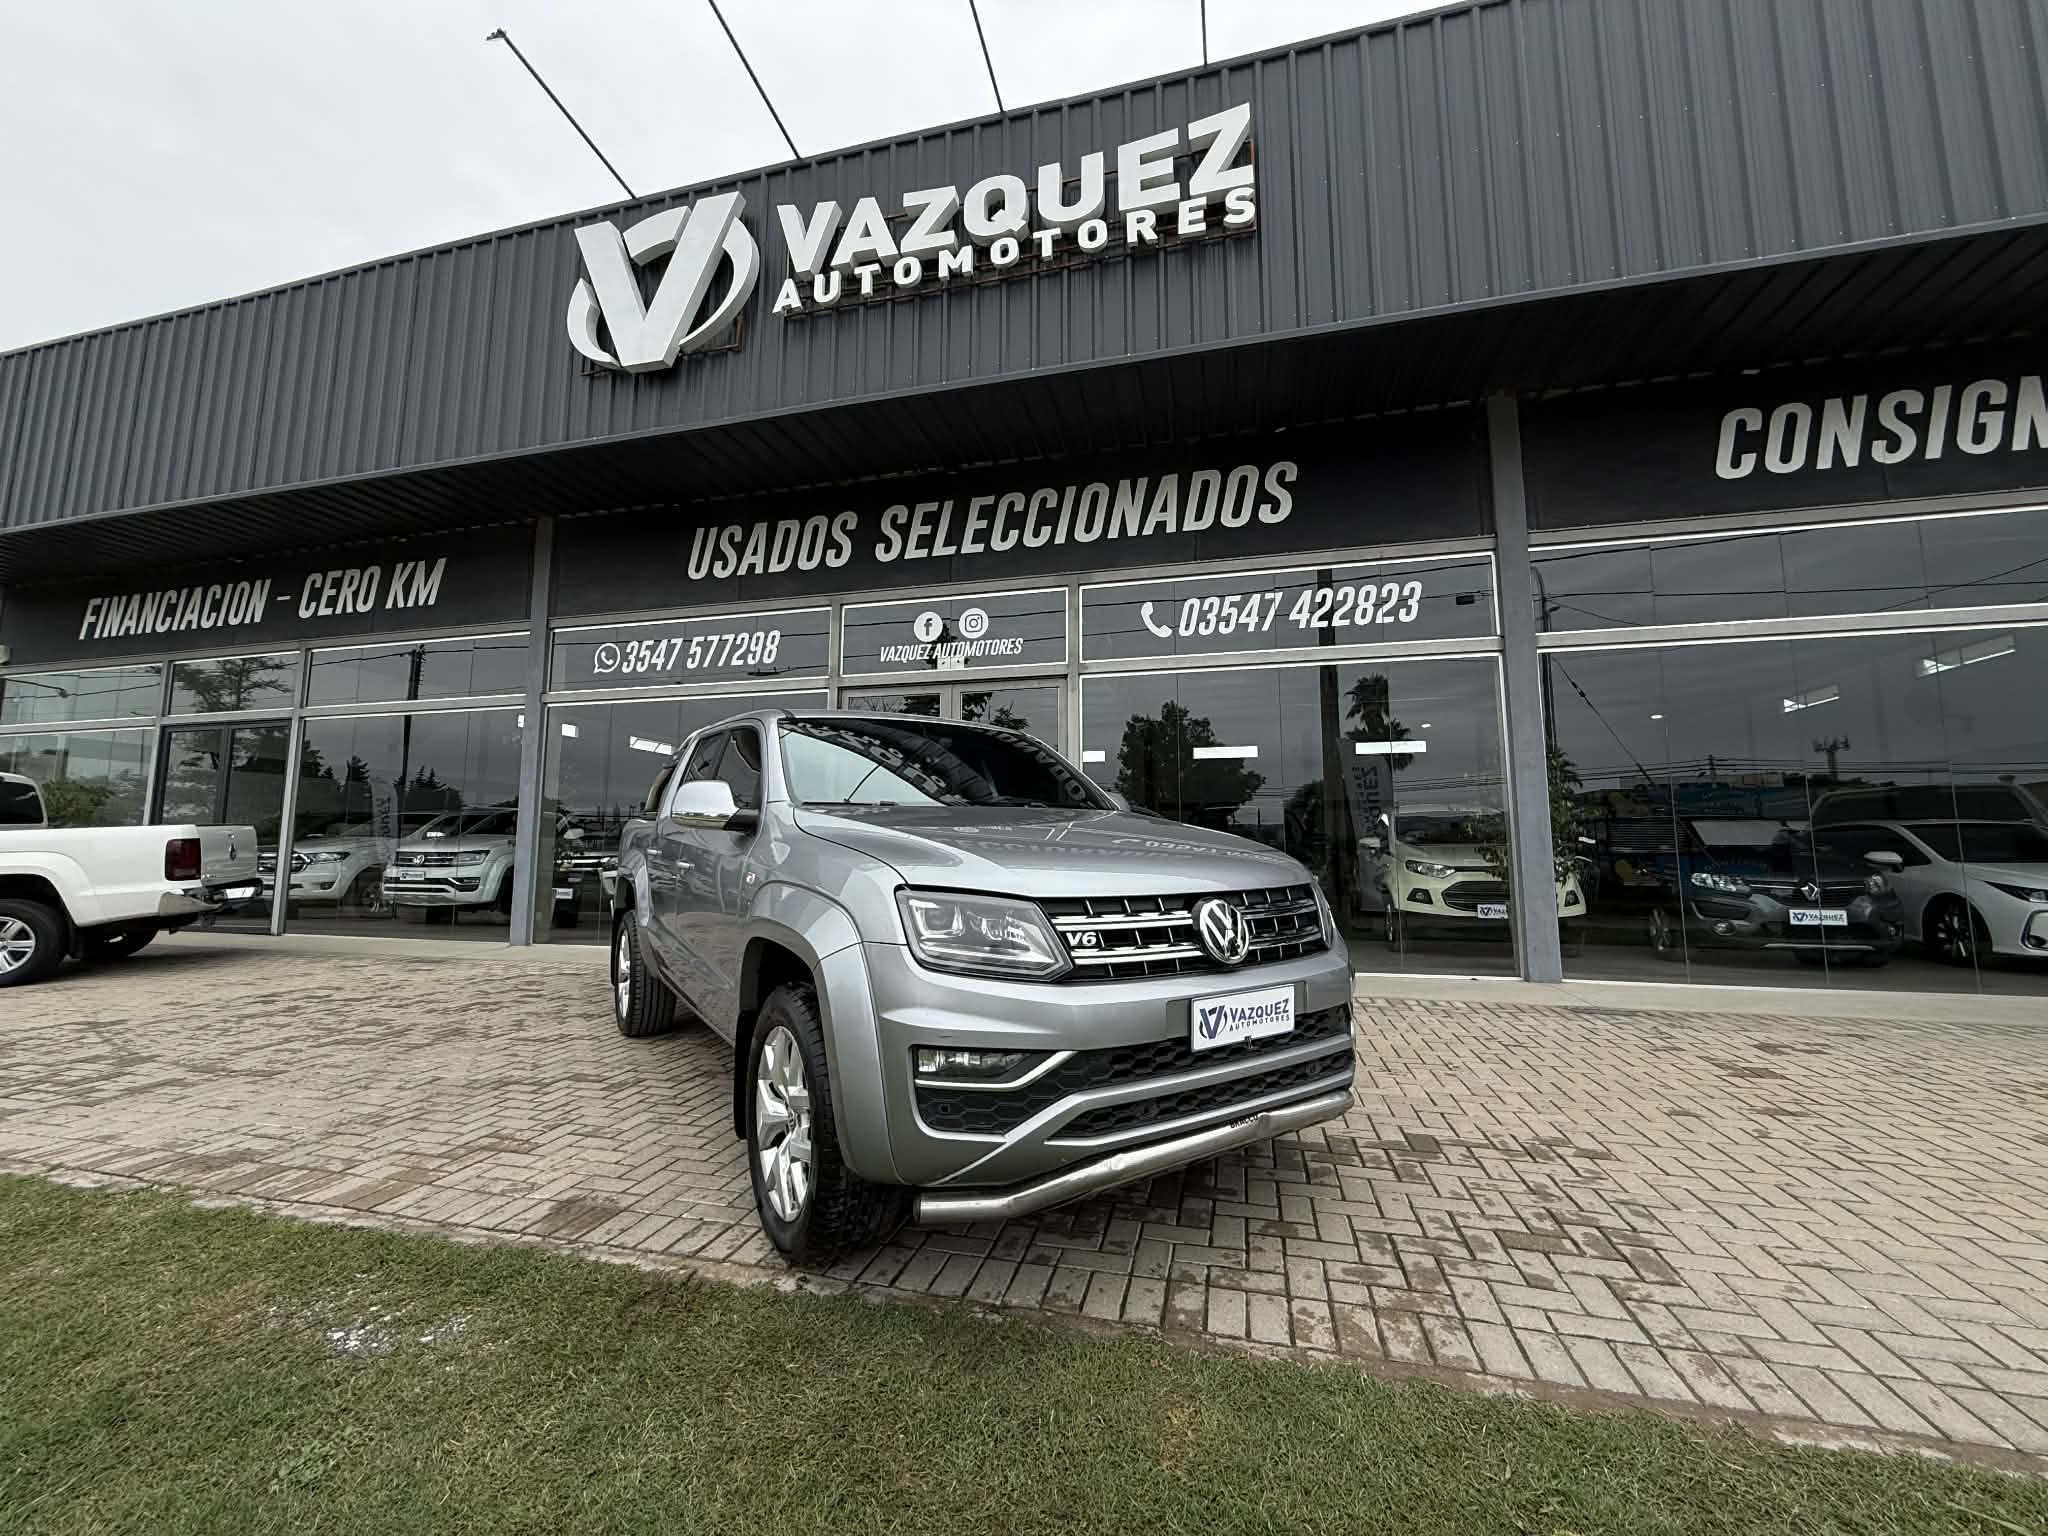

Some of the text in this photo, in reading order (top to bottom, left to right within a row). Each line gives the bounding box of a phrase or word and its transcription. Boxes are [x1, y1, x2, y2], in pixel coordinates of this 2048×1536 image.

[777, 101, 1251, 276] VAZQUEZ
[772, 186, 1257, 314] AUTOMOTORES
[687, 461, 1298, 580] USADOS SELECCIONADOS
[79, 579, 272, 640] FINANCIACION
[299, 565, 382, 619] CERO
[386, 557, 447, 609] KM
[1178, 581, 1423, 638] 03547 422823
[622, 630, 781, 674] 3547 577298
[880, 637, 1024, 662] VAZQUEZ AUTOMOTORES
[1066, 932, 1097, 946] V6
[1229, 1014, 1290, 1033] AUTOMOTORES
[1230, 998, 1290, 1023] VAZQUEZ
